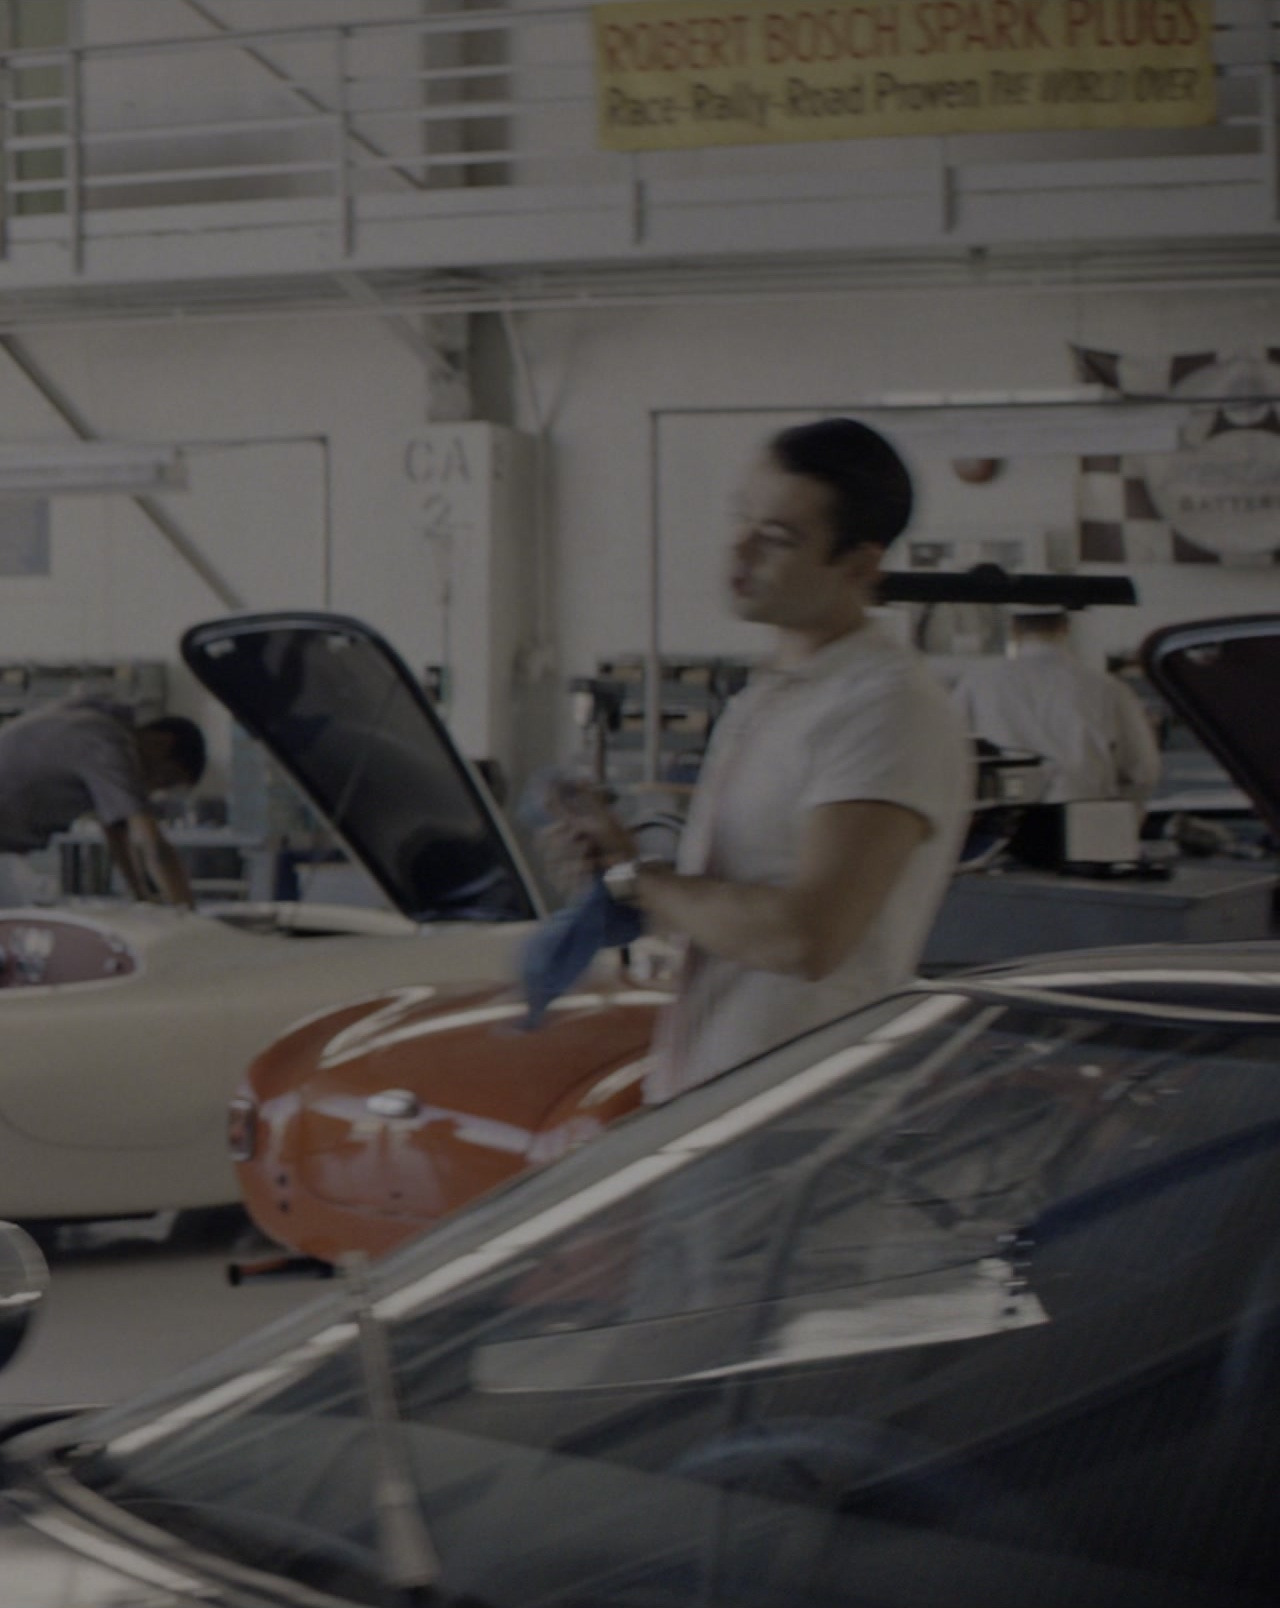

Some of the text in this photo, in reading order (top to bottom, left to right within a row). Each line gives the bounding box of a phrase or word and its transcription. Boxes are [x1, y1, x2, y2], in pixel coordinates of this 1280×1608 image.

[605, 0, 1200, 73] ROBERT BOSCH SPARK PLUGS
[875, 70, 981, 111] Proven
[1134, 64, 1201, 103] OVER
[404, 436, 471, 484] CA
